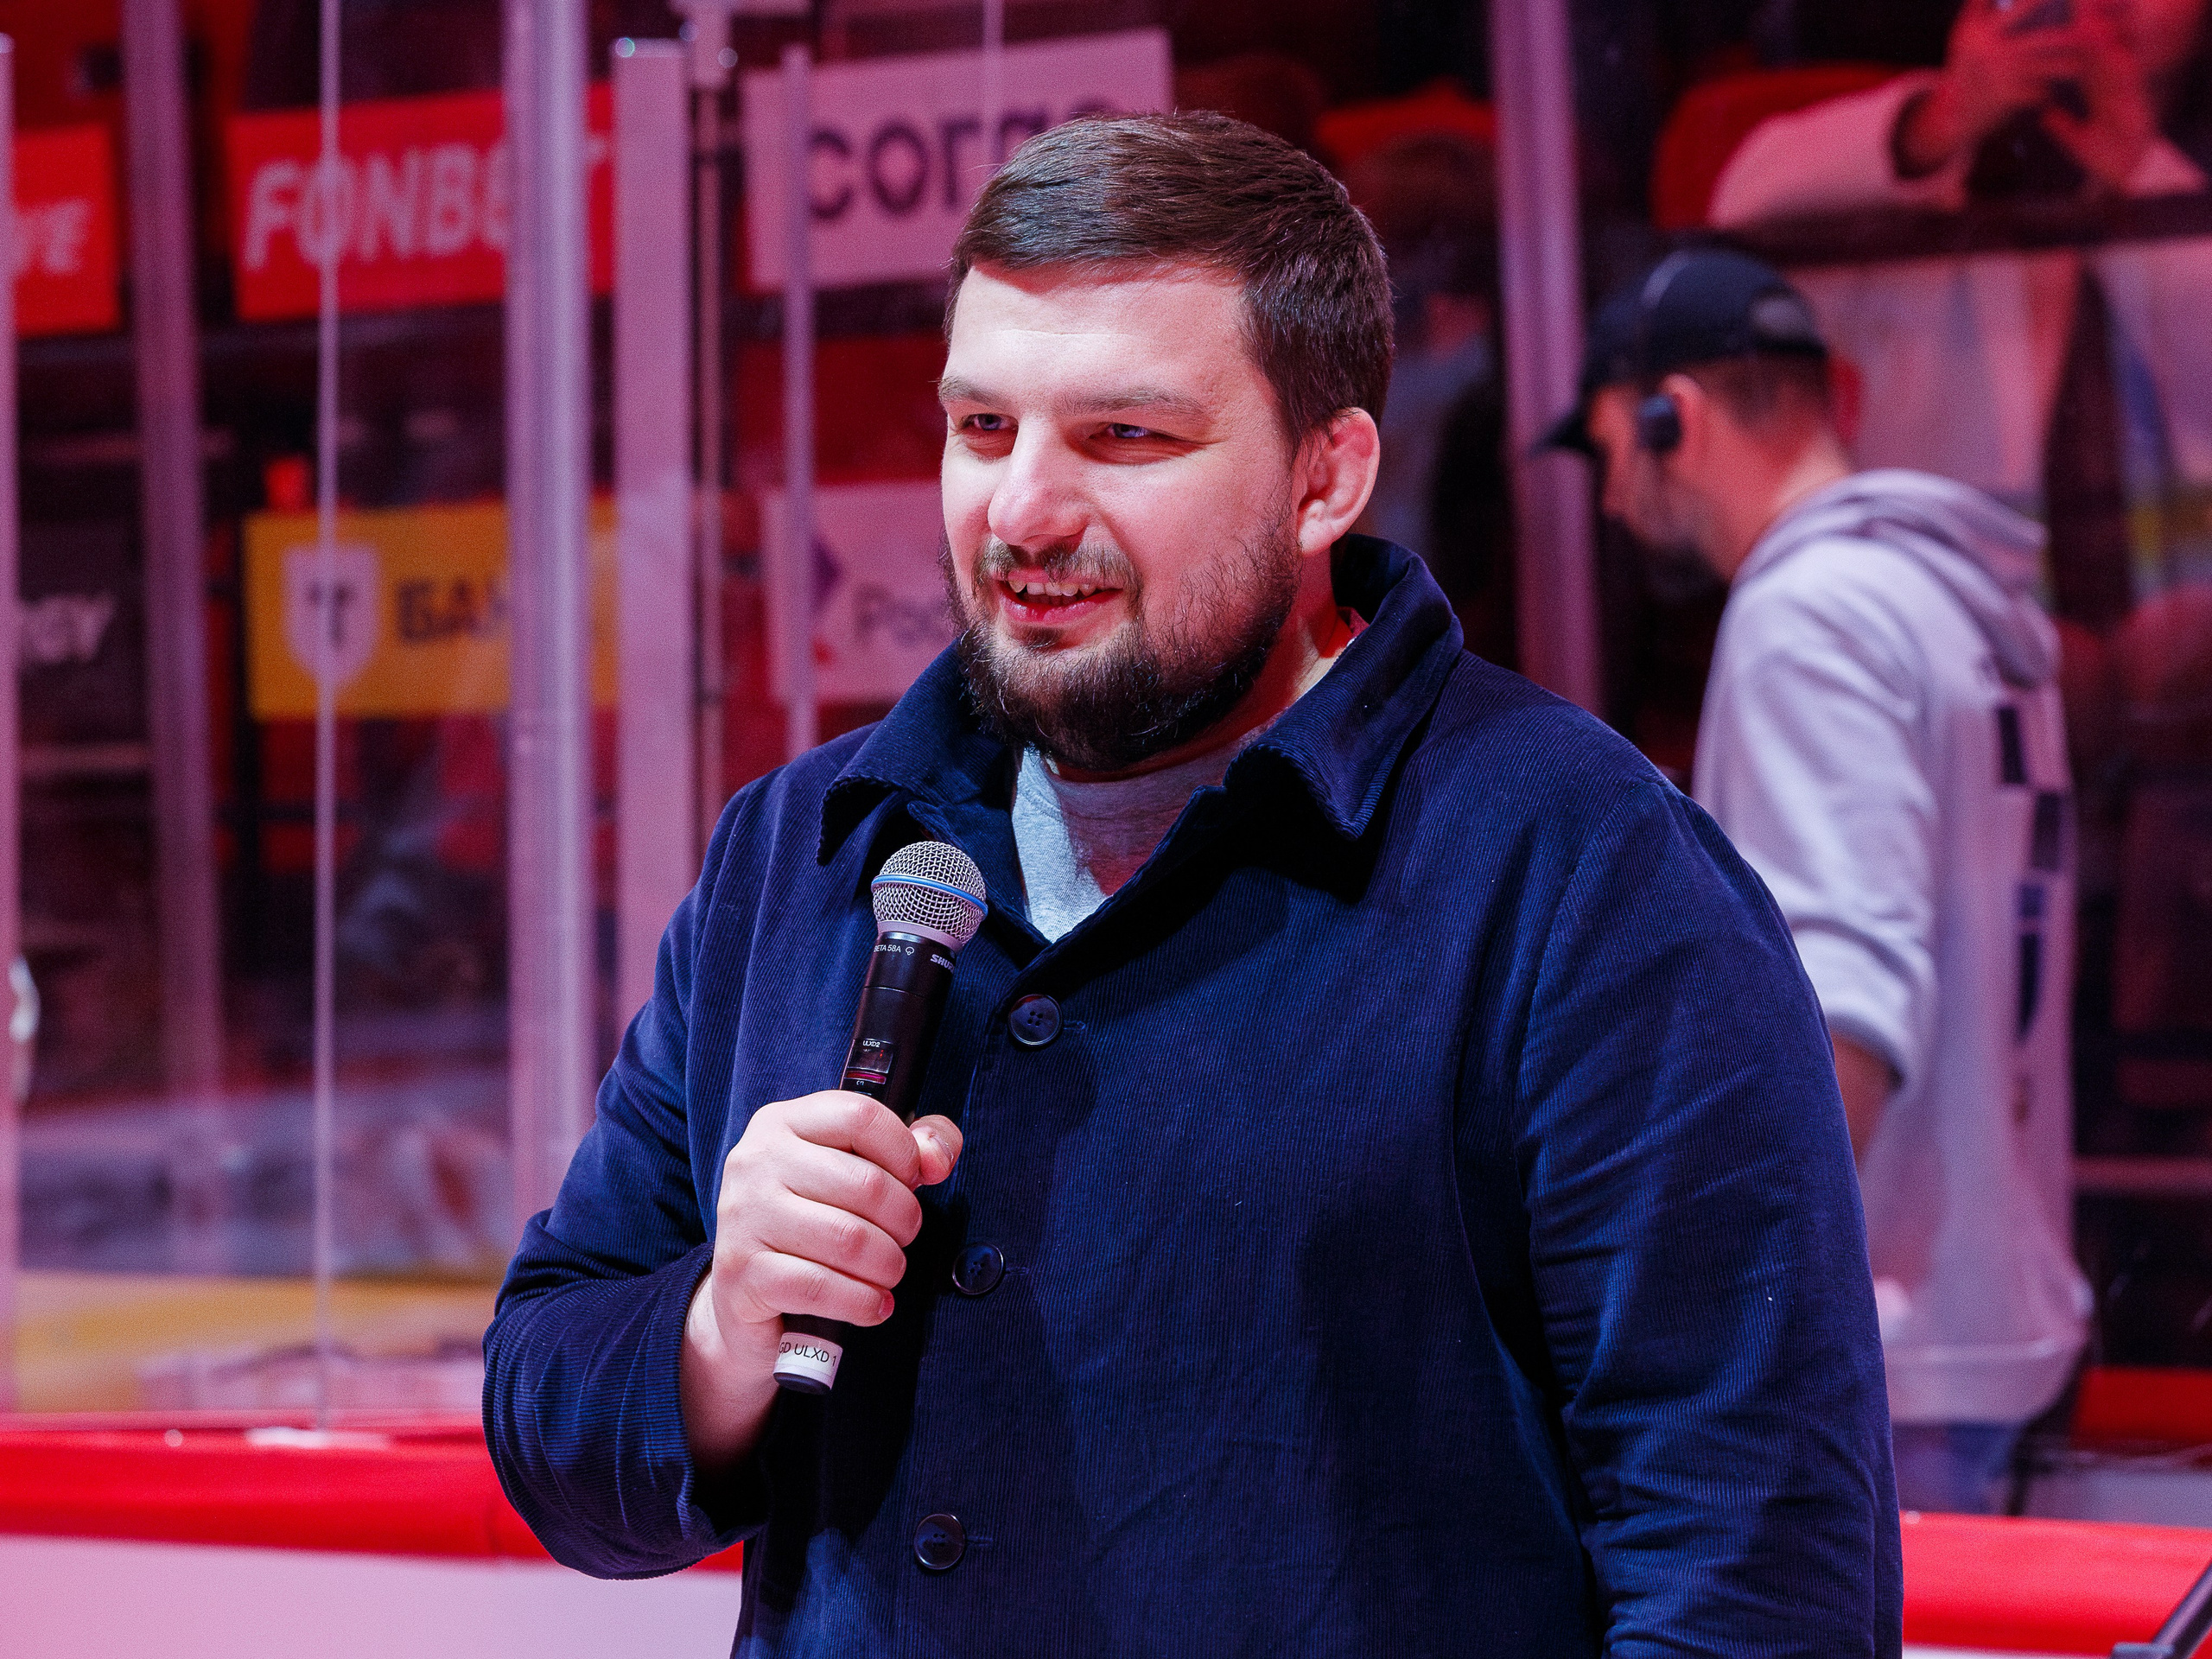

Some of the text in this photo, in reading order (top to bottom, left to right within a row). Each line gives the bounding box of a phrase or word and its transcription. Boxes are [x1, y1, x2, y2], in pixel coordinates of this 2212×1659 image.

[887, 944, 901, 953] 58A
[794, 1343, 830, 1363] ULXD
[832, 1355, 837, 1367] 1
